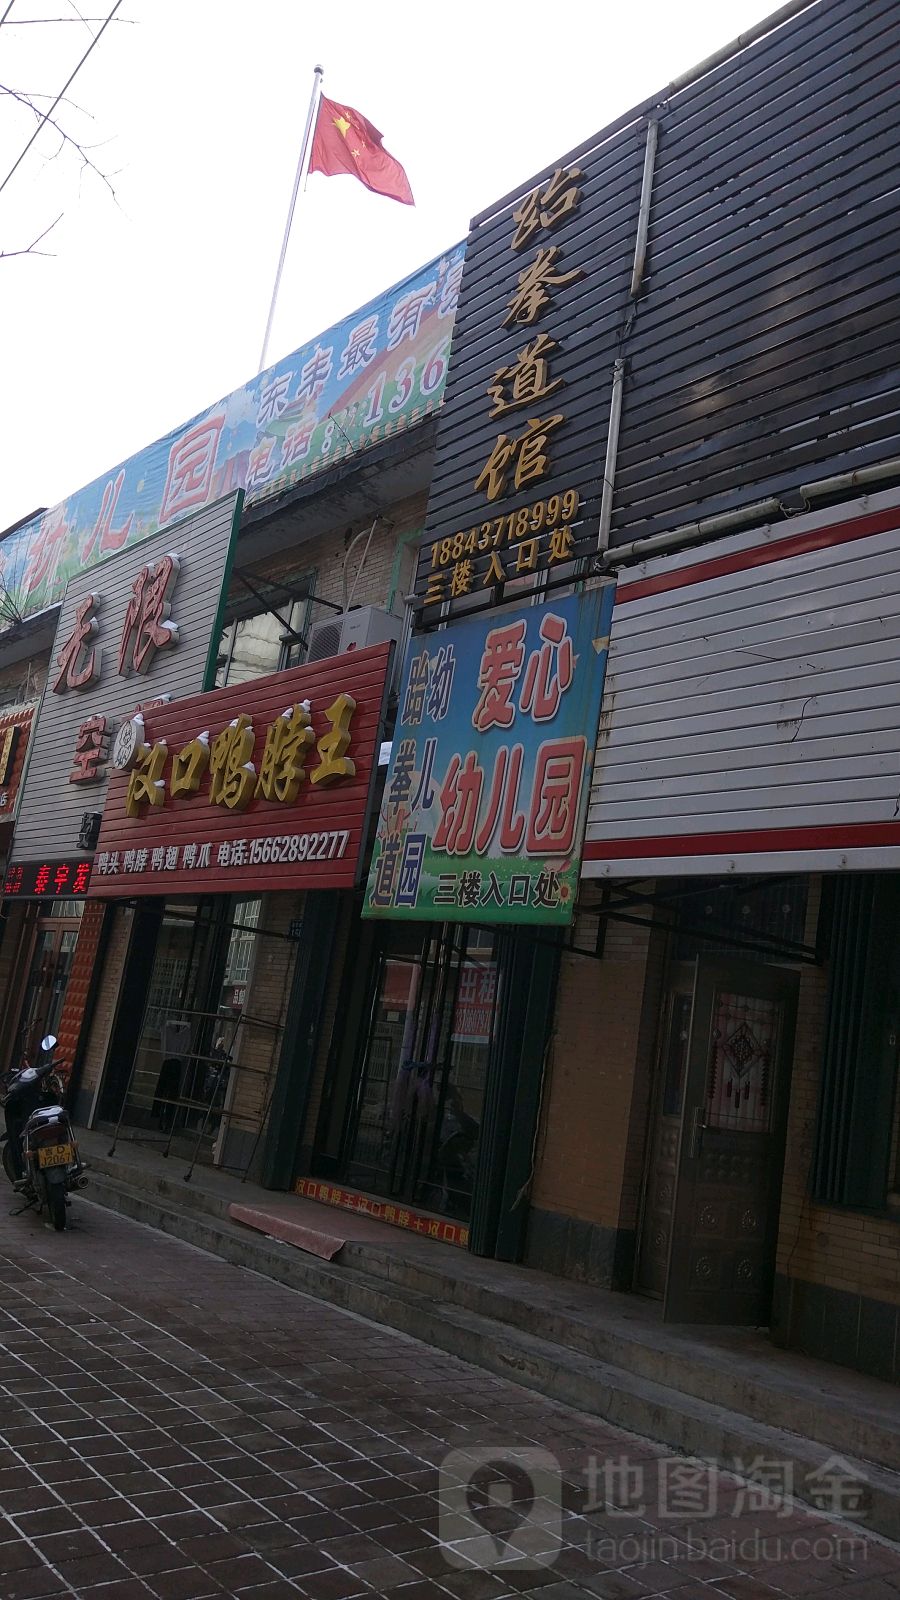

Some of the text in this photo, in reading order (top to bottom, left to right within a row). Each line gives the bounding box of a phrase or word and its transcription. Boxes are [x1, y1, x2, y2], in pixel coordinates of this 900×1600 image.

[475, 168, 586, 501] 跆拳道馆
[423, 526, 576, 604] 三楼入口处
[430, 489, 579, 569] 18843718999
[472, 612, 573, 732] 爱心
[125, 693, 357, 817] 汉口鸭脖王
[369, 648, 431, 909] 跆拳道
[394, 643, 456, 908] 幼儿园
[431, 735, 588, 857] 幼儿园
[97, 850, 120, 875] 鸭头
[123, 847, 148, 873] 鸭脖
[182, 842, 213, 869] 鸭爪
[432, 870, 562, 908] 三楼入口处
